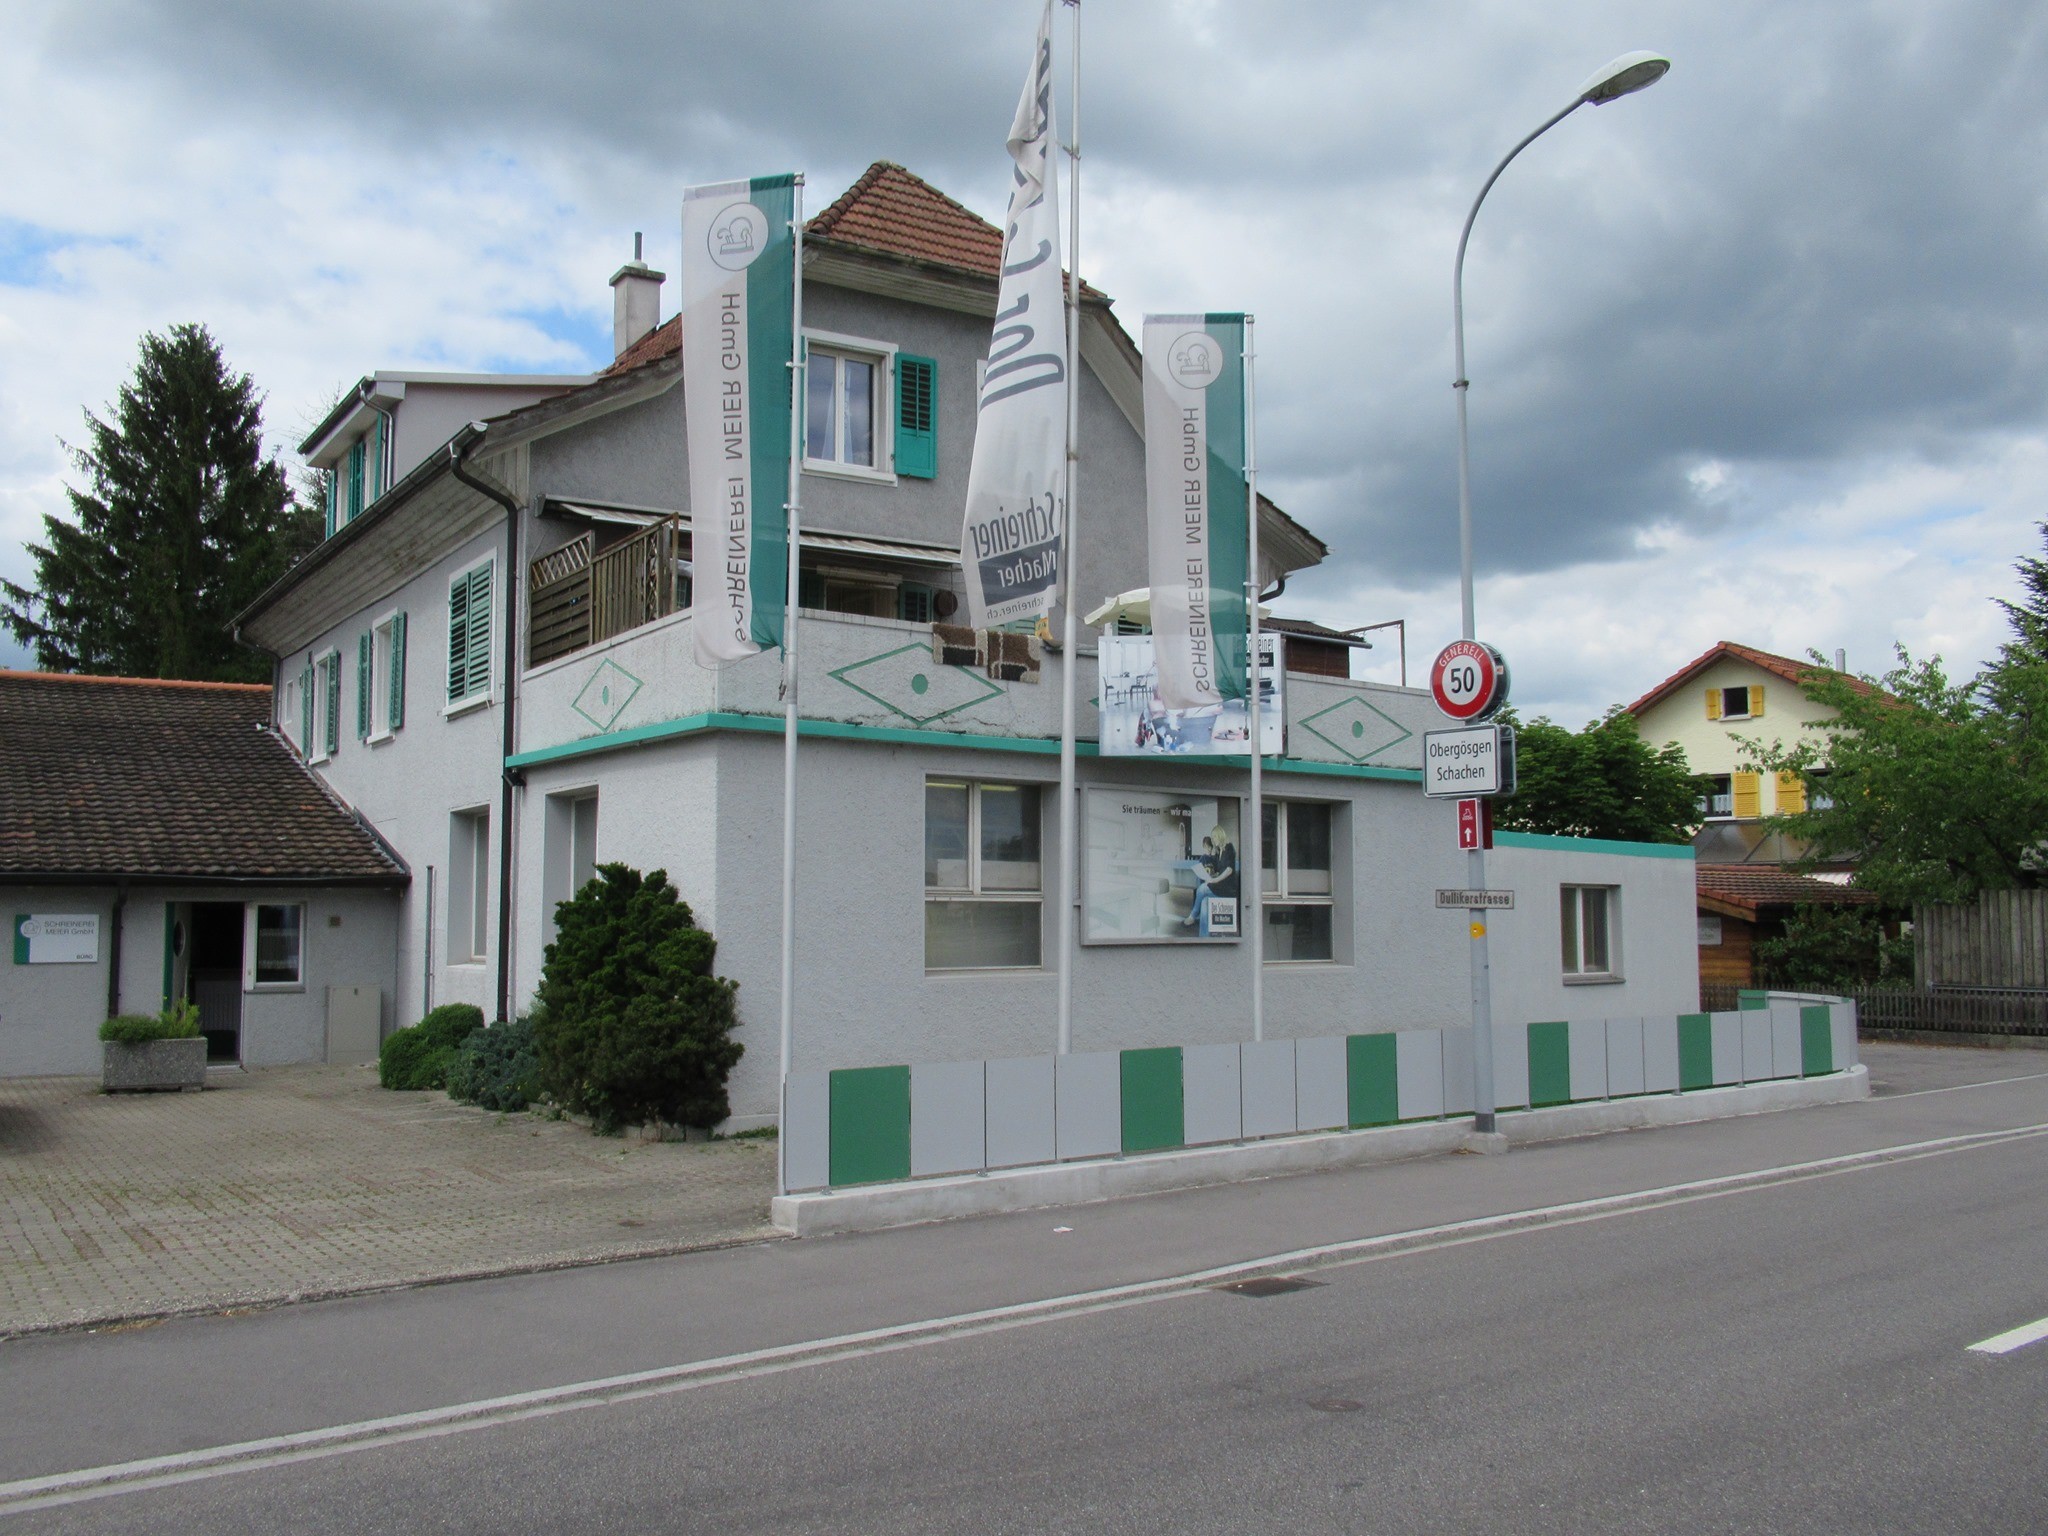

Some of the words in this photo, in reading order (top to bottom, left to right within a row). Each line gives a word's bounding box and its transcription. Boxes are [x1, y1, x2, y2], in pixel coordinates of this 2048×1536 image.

[1438, 643, 1484, 668] GENERELL
[1450, 666, 1475, 694] 50
[1429, 740, 1492, 759] Obergösgen
[1437, 764, 1485, 781] Schachen
[1122, 804, 1133, 814] Sie
[1133, 805, 1161, 815] träumen
[1440, 891, 1510, 905] Dullikerstrasse
